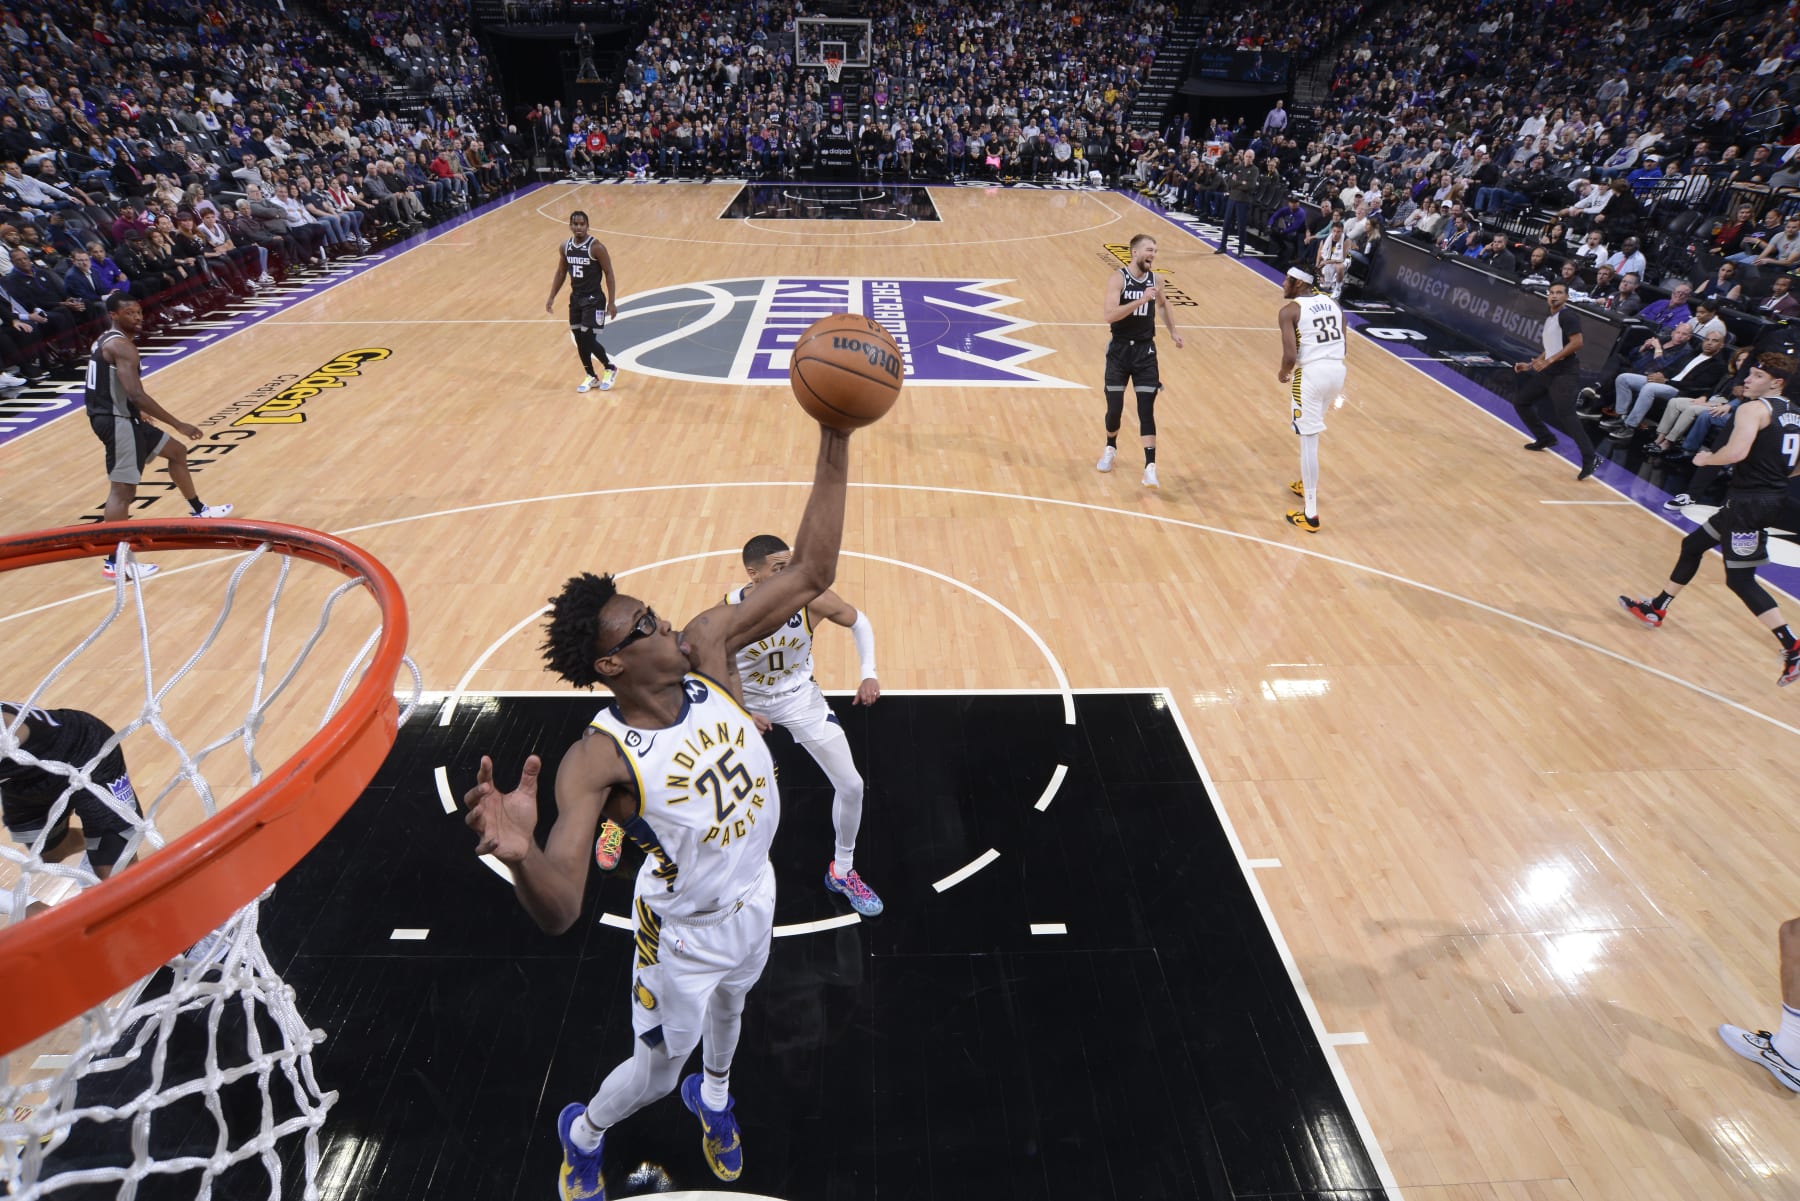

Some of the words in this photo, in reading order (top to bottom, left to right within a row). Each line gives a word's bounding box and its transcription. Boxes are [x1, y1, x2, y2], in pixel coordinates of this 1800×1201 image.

[567, 256, 591, 265] KINGS
[573, 265, 584, 278] 15
[1309, 303, 1332, 315] TURNER
[1396, 265, 1450, 301] PROTECT
[1452, 287, 1490, 320] YOUR
[1492, 306, 1546, 345] BUSINE
[1313, 315, 1341, 344] 33
[832, 336, 900, 380] Wilson
[244, 373, 300, 399] Credit
[198, 399, 258, 427] Union
[1782, 433, 1800, 467] 9
[744, 635, 807, 662] INDIANA
[768, 650, 785, 672] 0
[666, 721, 747, 806] INDIANA
[693, 747, 754, 824] 25
[701, 776, 767, 849] PACERS
